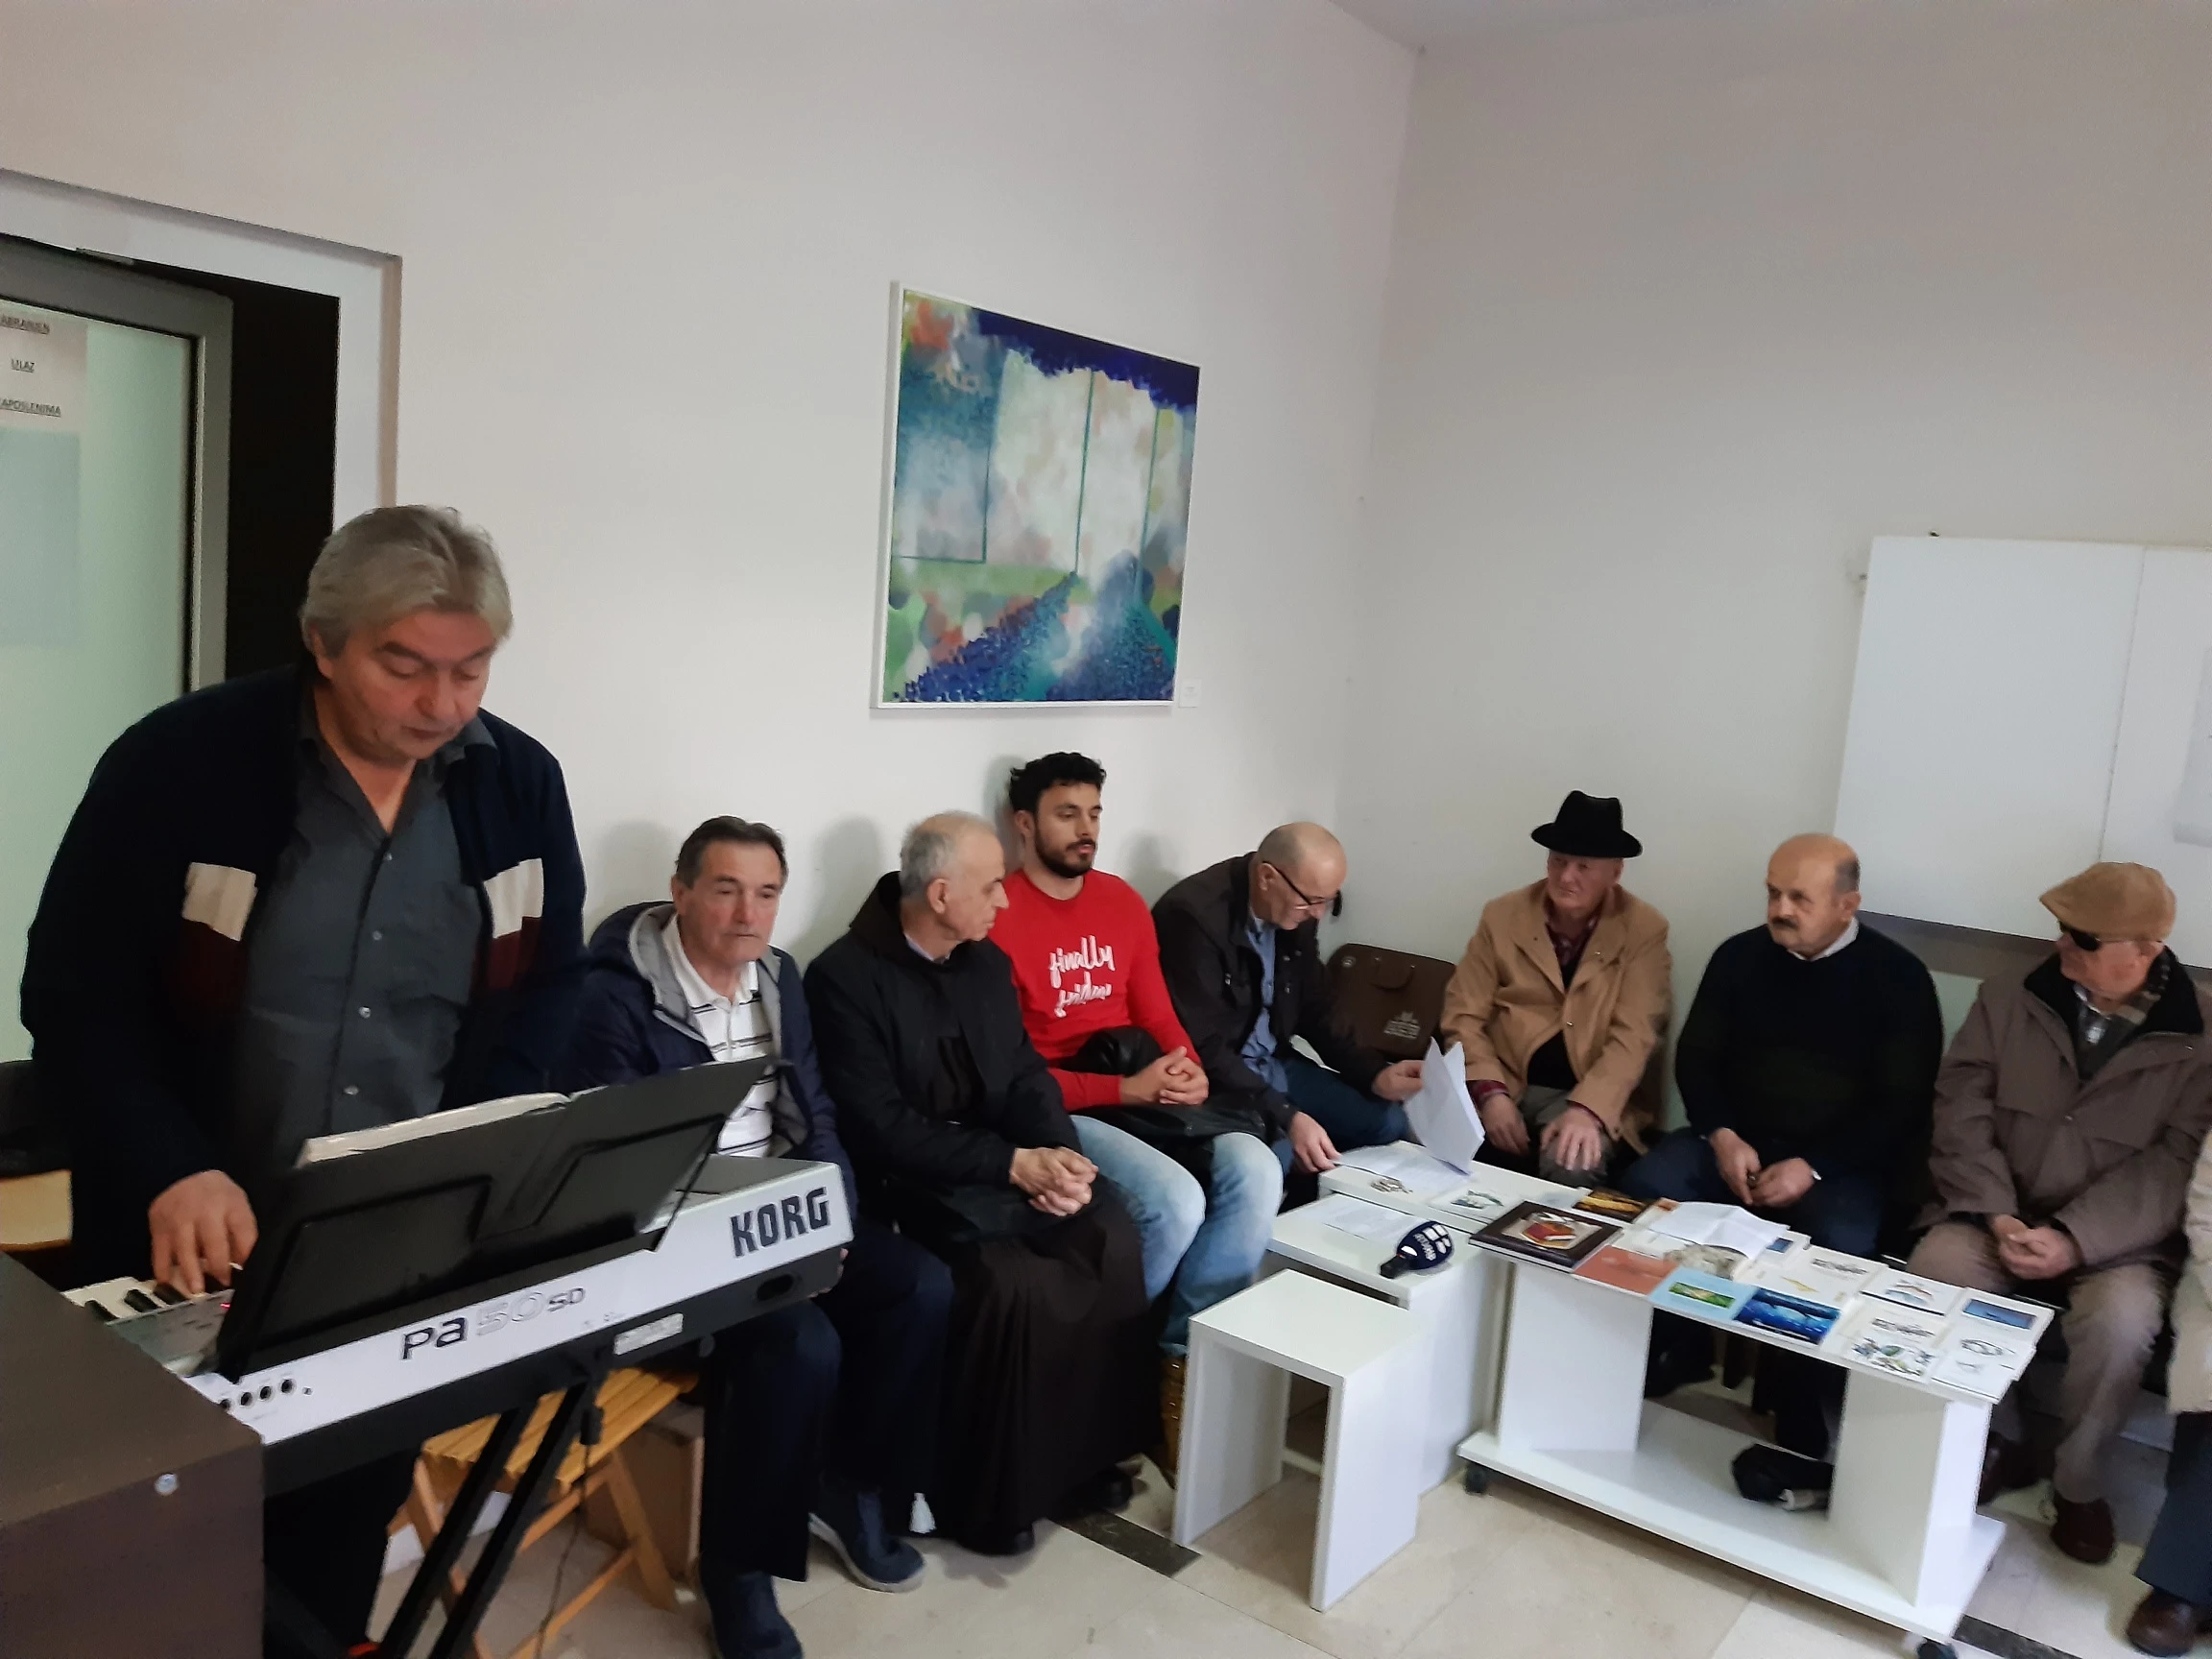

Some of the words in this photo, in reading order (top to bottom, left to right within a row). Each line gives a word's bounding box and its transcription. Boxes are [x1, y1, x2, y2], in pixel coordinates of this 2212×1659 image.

[0, 314, 50, 334] ABRANJEN
[11, 358, 36, 373] ULAZ
[0, 397, 61, 416] APOSLENIMA
[1048, 934, 1117, 989] finally
[730, 1187, 830, 1257] KORG
